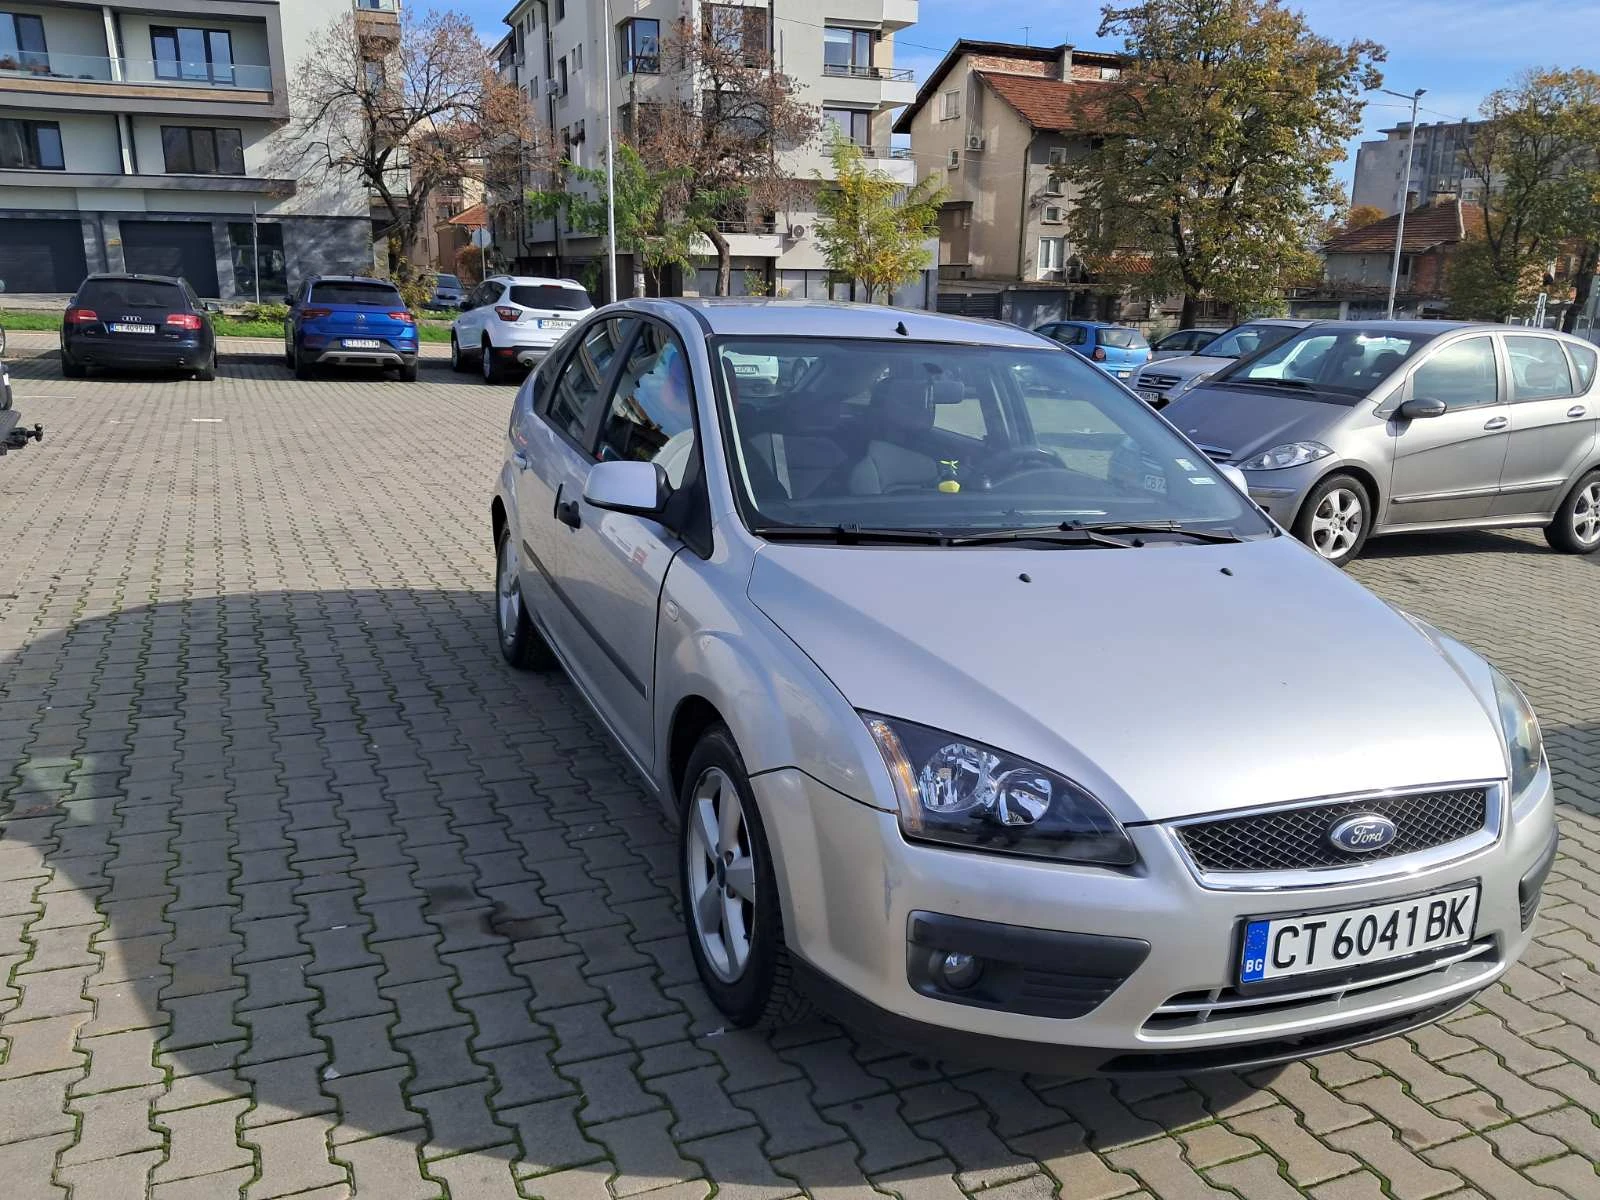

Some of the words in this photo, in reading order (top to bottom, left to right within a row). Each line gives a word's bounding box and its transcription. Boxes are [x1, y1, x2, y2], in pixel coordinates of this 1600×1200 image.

[1350, 824, 1385, 845] Ford
[1272, 920, 1327, 969] CT
[1332, 905, 1419, 960] 6041
[1425, 895, 1471, 943] BK
[1245, 958, 1263, 973] BG
